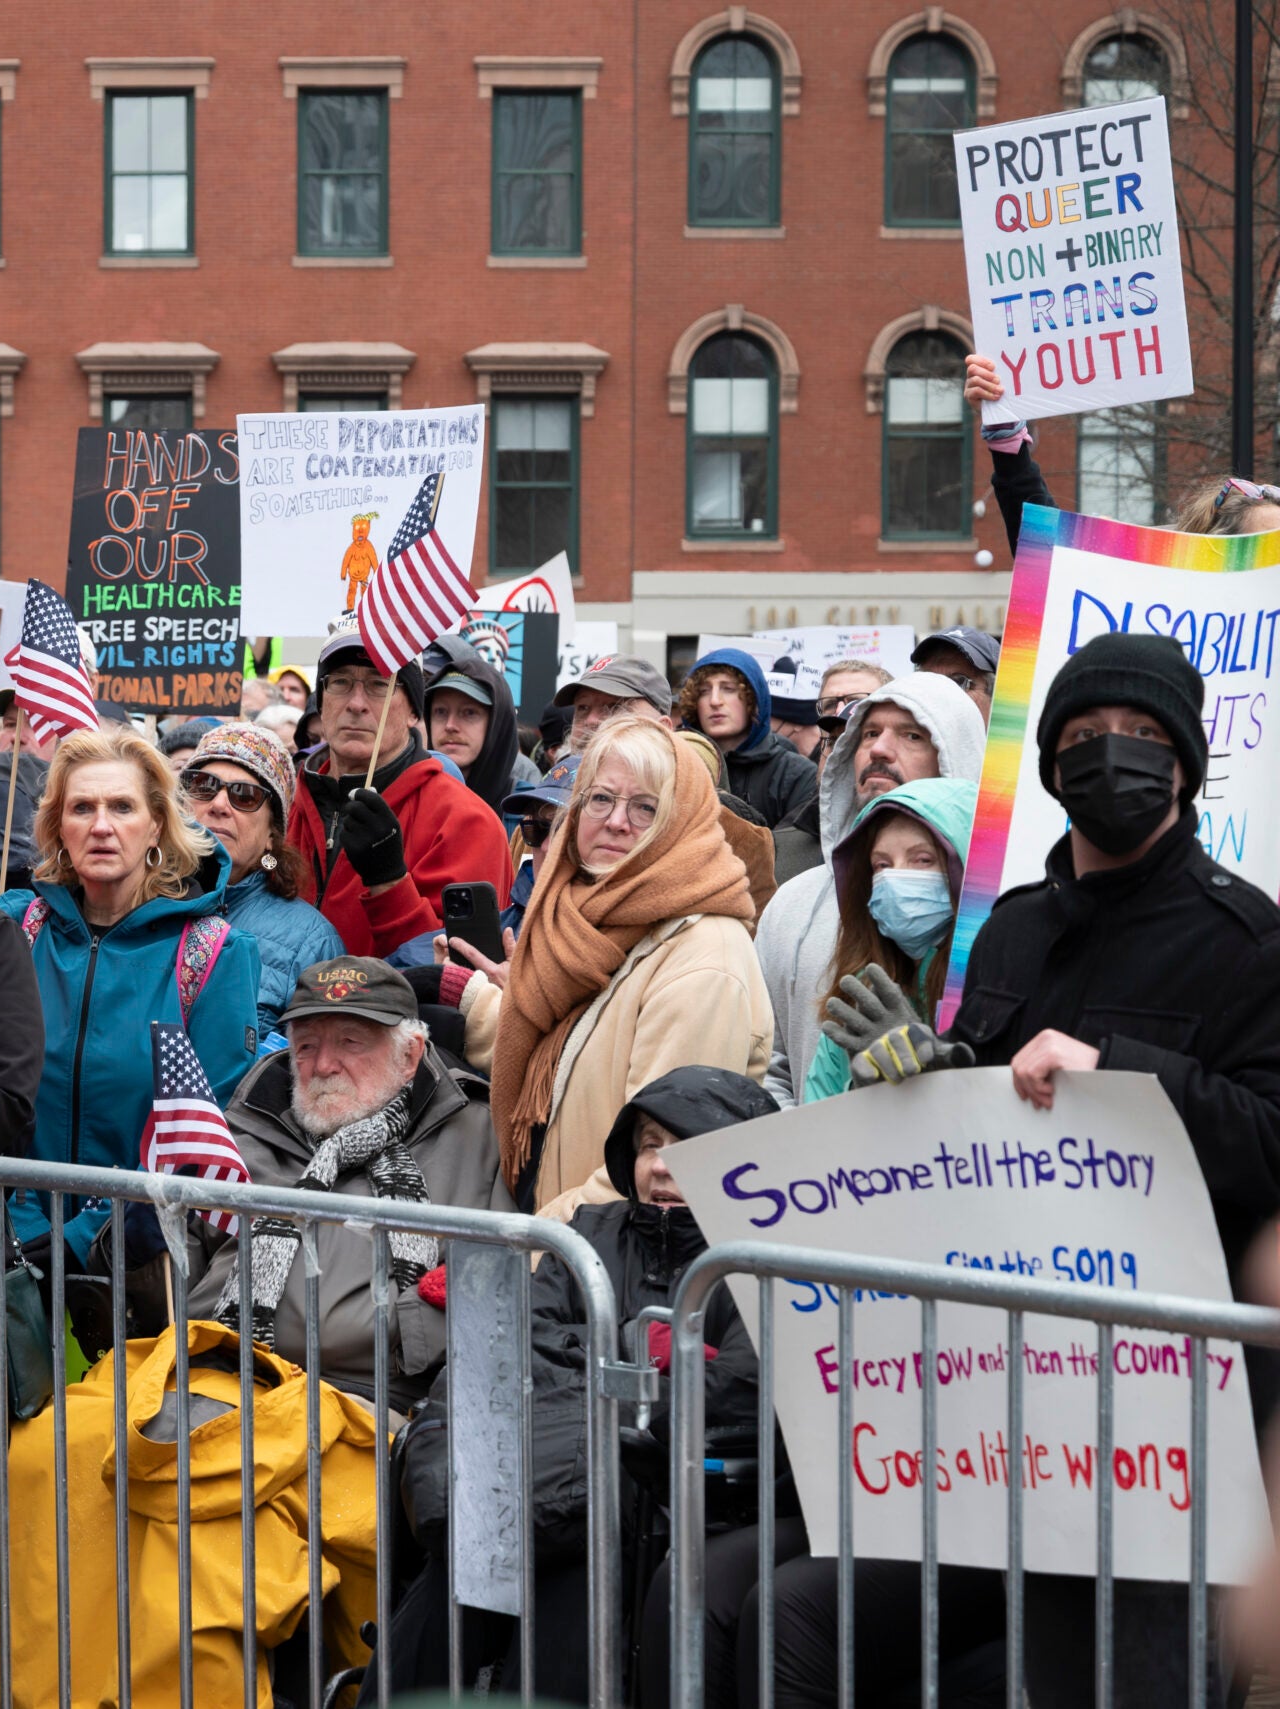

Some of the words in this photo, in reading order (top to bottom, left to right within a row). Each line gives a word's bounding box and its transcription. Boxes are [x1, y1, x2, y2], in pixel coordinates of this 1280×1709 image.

[966, 114, 1151, 192] PROTECT
[995, 172, 1144, 233] QUEER
[986, 243, 1046, 286] NON
[991, 271, 1158, 337] TRANS
[1001, 325, 1163, 396] YOUTH
[243, 420, 329, 450] THESE
[338, 413, 480, 453] DEPORTATIONS
[103, 430, 240, 489] HANDS
[246, 456, 294, 487] ARE
[305, 452, 446, 481] COMPENSATING
[448, 450, 472, 471] FOR
[105, 483, 201, 533] OFF
[88, 530, 211, 585] OUR
[96, 647, 134, 668] VIL
[143, 642, 236, 667] RIGHTS
[144, 616, 239, 642] SPEECH
[94, 675, 170, 706] TIONAL
[173, 671, 242, 707] PARKS
[1201, 692, 1267, 750] HTS
[317, 969, 368, 984] USMC
[934, 1141, 993, 1189] tell
[996, 1140, 1055, 1189] the
[1058, 1137, 1154, 1196] Story
[978, 1343, 1005, 1373] and
[1005, 1343, 1063, 1376] hen
[956, 1449, 977, 1479] a
[980, 1431, 1052, 1489] litle
[1062, 1443, 1191, 1511] wong
